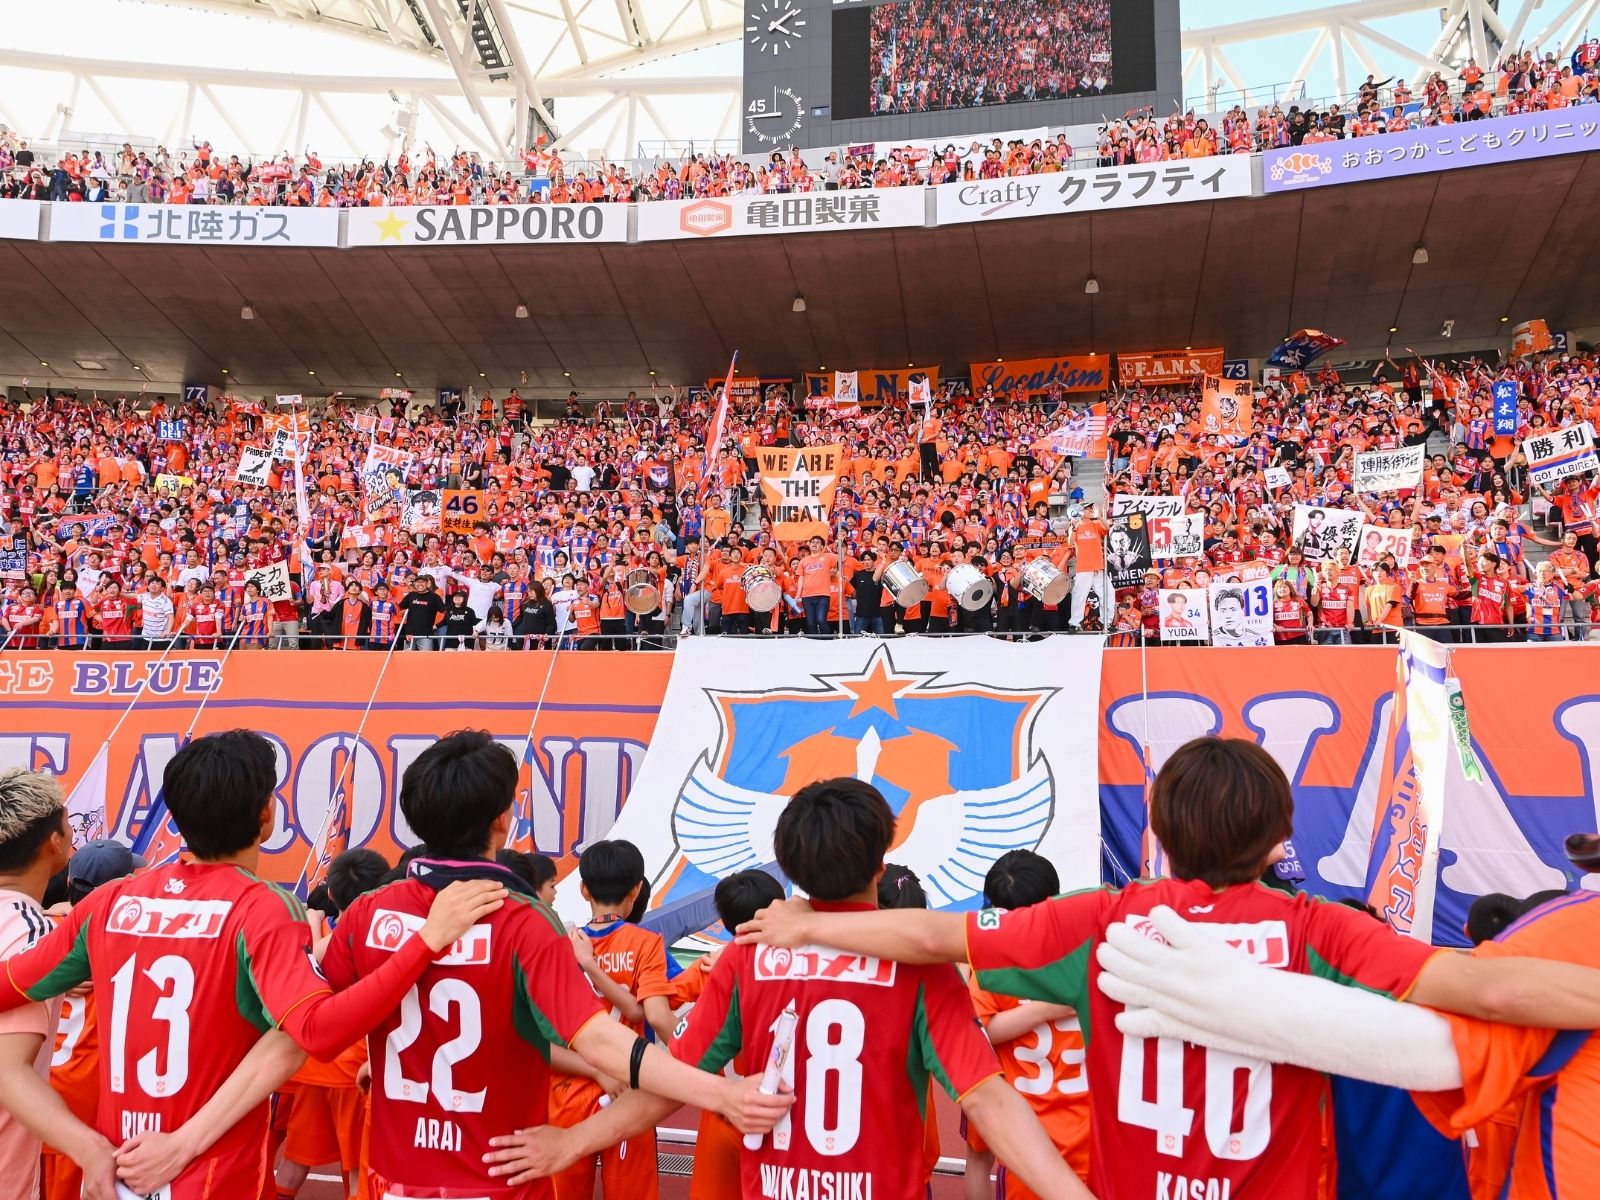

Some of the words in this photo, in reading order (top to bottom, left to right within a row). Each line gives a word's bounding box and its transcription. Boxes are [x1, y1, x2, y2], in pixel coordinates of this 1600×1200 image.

[748, 99, 766, 113] 45
[1341, 120, 1599, 169] おおつかこどもクリニッ
[958, 181, 1041, 207] Crafty
[1058, 166, 1227, 207] クラフティ
[415, 205, 604, 242] SAPPORO
[747, 194, 880, 228] 亀田製菓
[147, 208, 290, 242] 北陸ガス
[1554, 333, 1566, 349] 2
[979, 361, 1104, 397] Localism
[1135, 359, 1206, 377] F.A.N.S.
[1224, 364, 1247, 378] 73
[185, 386, 206, 399] 77
[245, 446, 264, 458] PRIDE
[264, 450, 273, 458] OF
[1530, 427, 1586, 460] 勝利
[763, 454, 788, 472] WE
[796, 454, 835, 472] ARE
[1534, 471, 1552, 482] GO!
[1556, 458, 1598, 476] ALBIREX
[238, 473, 265, 485] NIIGATA
[781, 479, 820, 497] THE
[446, 495, 478, 514] 46
[1118, 499, 1182, 517] アイシテル
[1129, 514, 1143, 530] 5
[1147, 517, 1172, 549] 15
[1385, 534, 1408, 558] 26
[1187, 608, 1201, 618] 34
[1243, 585, 1269, 617] 13
[1168, 628, 1198, 637] YUDAI
[71, 659, 223, 695] BLUE
[137, 911, 224, 936] コメリ
[110, 952, 196, 1099] 13
[384, 978, 488, 1114] 22
[768, 997, 866, 1157] 18
[121, 1109, 161, 1141] RIKU
[413, 1116, 462, 1152] ARAI
[760, 1162, 873, 1200] WKATSUKI
[1156, 1170, 1231, 1200] KASAI
